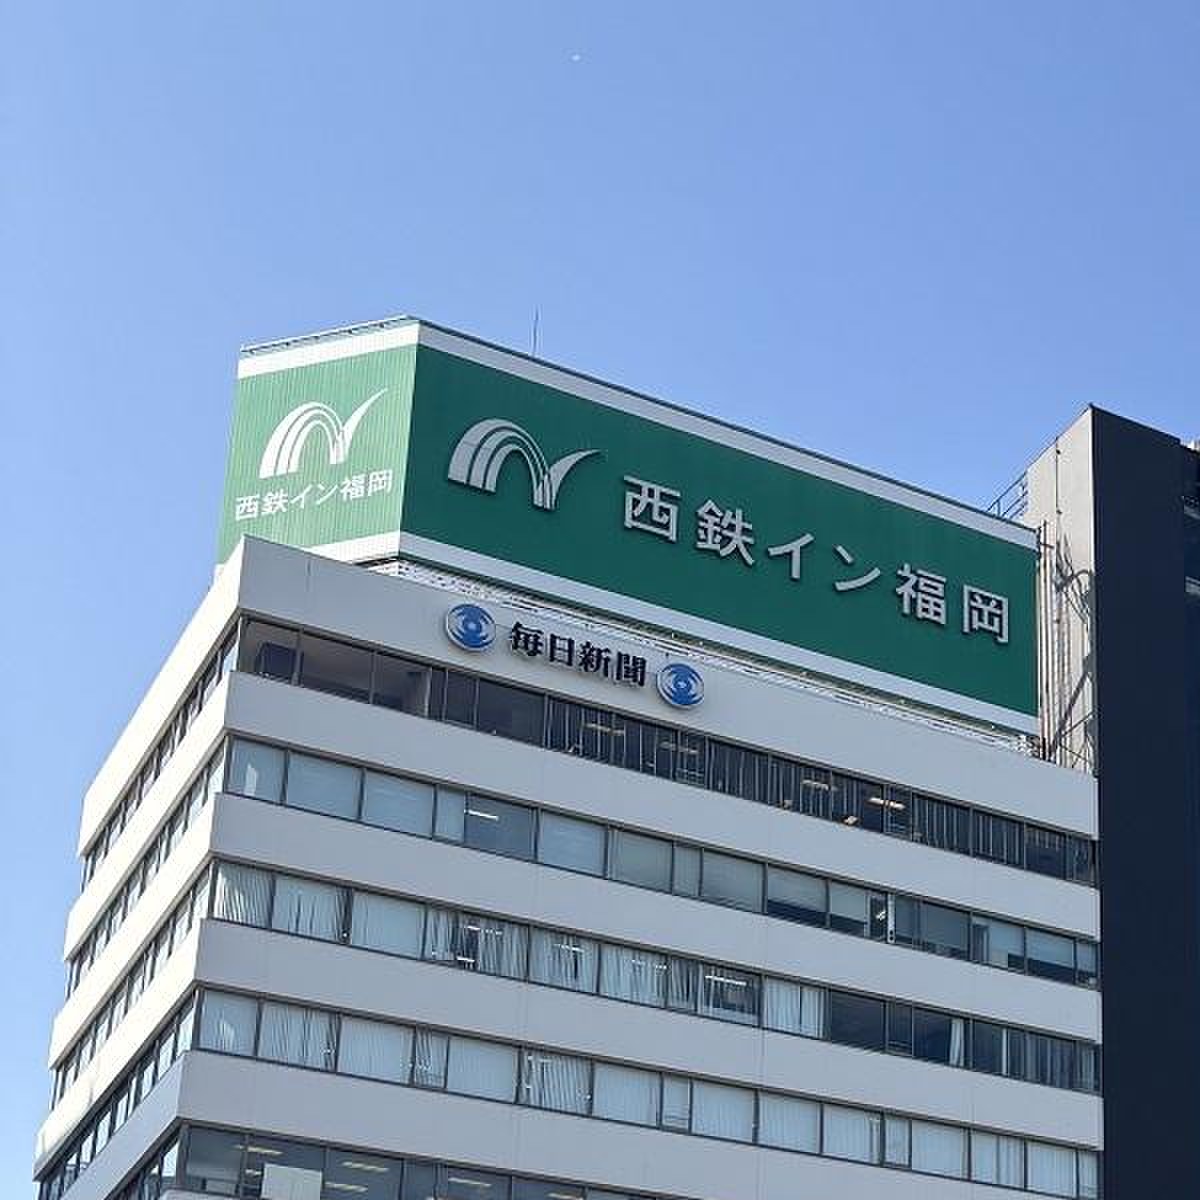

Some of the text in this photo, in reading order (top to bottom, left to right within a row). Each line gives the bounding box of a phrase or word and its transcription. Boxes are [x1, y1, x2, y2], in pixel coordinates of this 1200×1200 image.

[235, 469, 393, 521] 西鉄イン福岡
[622, 474, 1009, 644] 西鉄イン福岡
[511, 621, 647, 687] 毎日新聞
